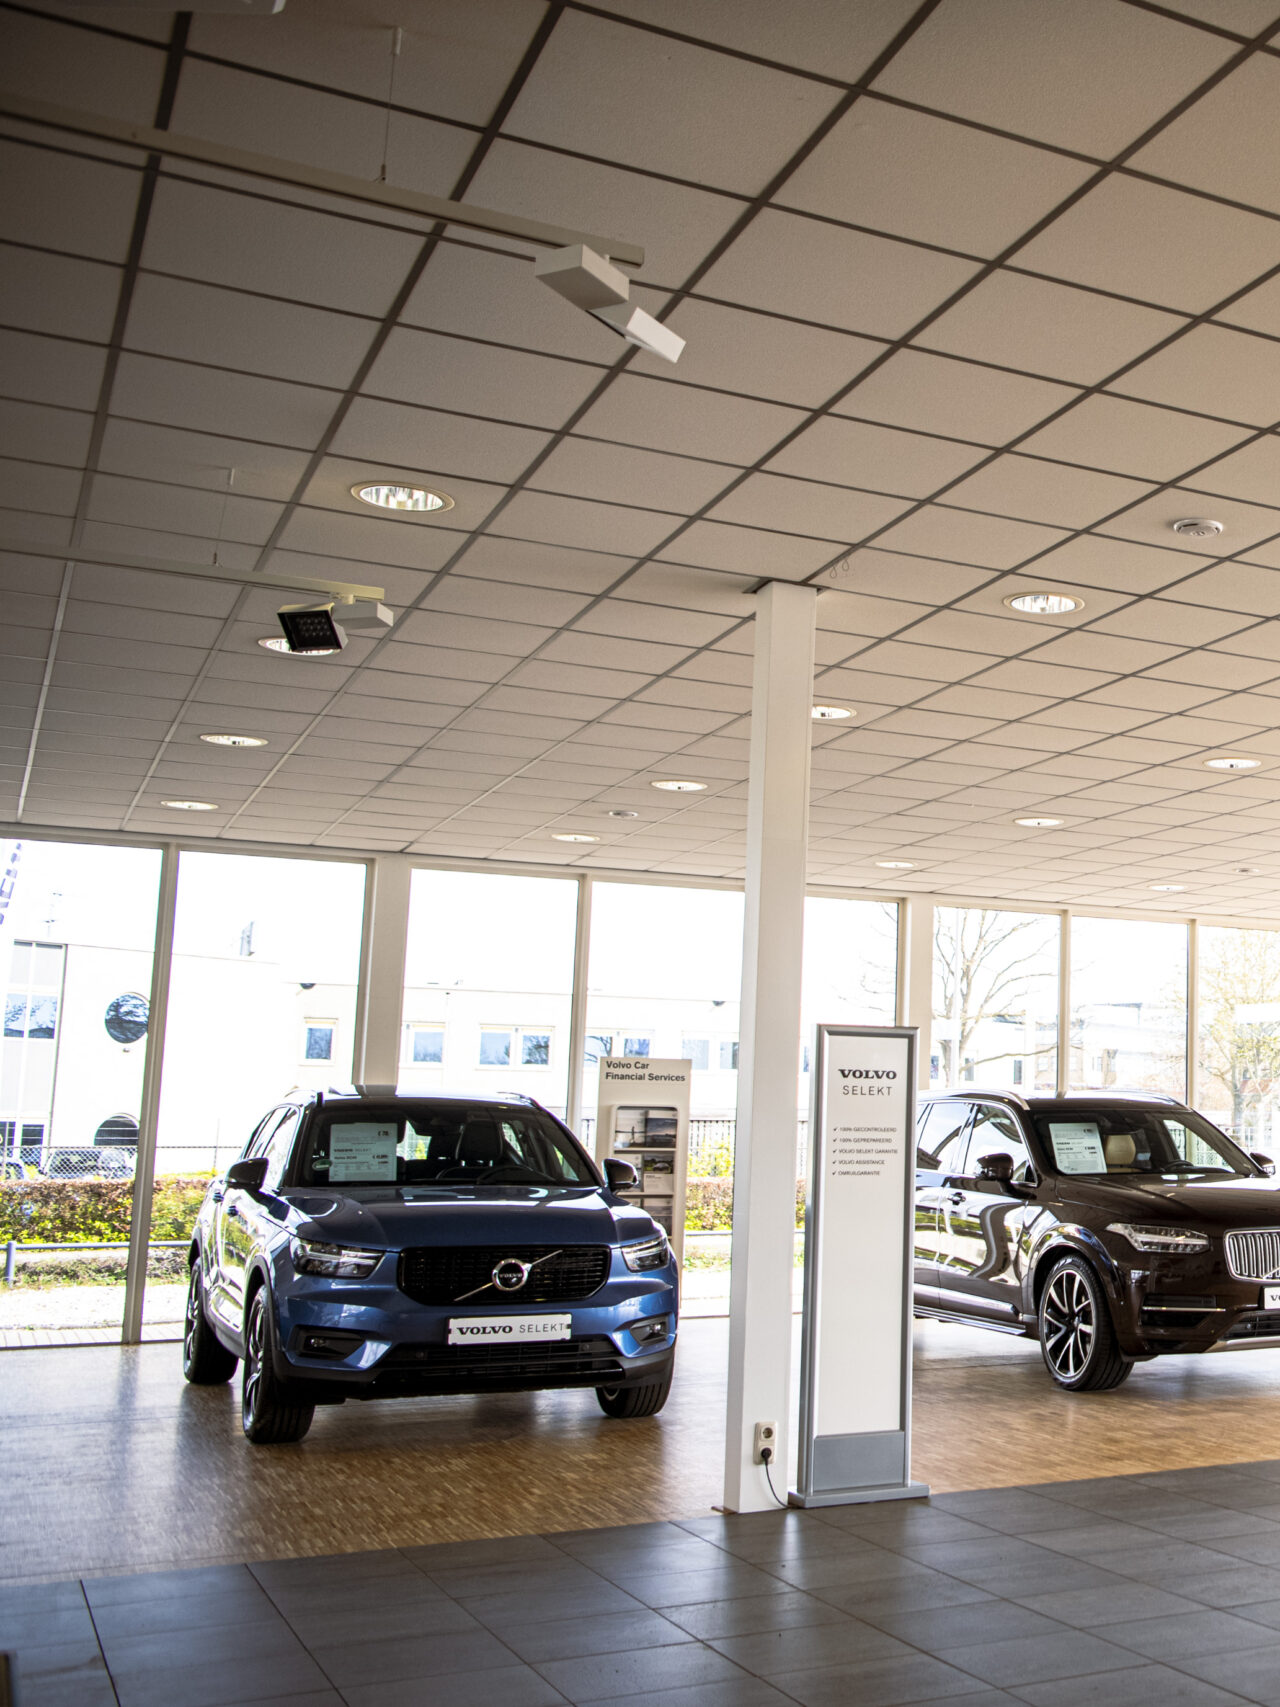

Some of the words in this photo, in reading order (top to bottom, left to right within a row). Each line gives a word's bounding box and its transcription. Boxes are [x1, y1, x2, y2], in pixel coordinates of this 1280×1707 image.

[606, 1061, 631, 1069] Volvo
[634, 1061, 650, 1069] Car
[605, 1072, 646, 1080] Financial
[648, 1073, 686, 1082] Services
[838, 1069, 897, 1080] VOLVO
[842, 1085, 893, 1096] SELEKT
[457, 1325, 513, 1335] VOLVO
[519, 1323, 565, 1333] SELEKT
